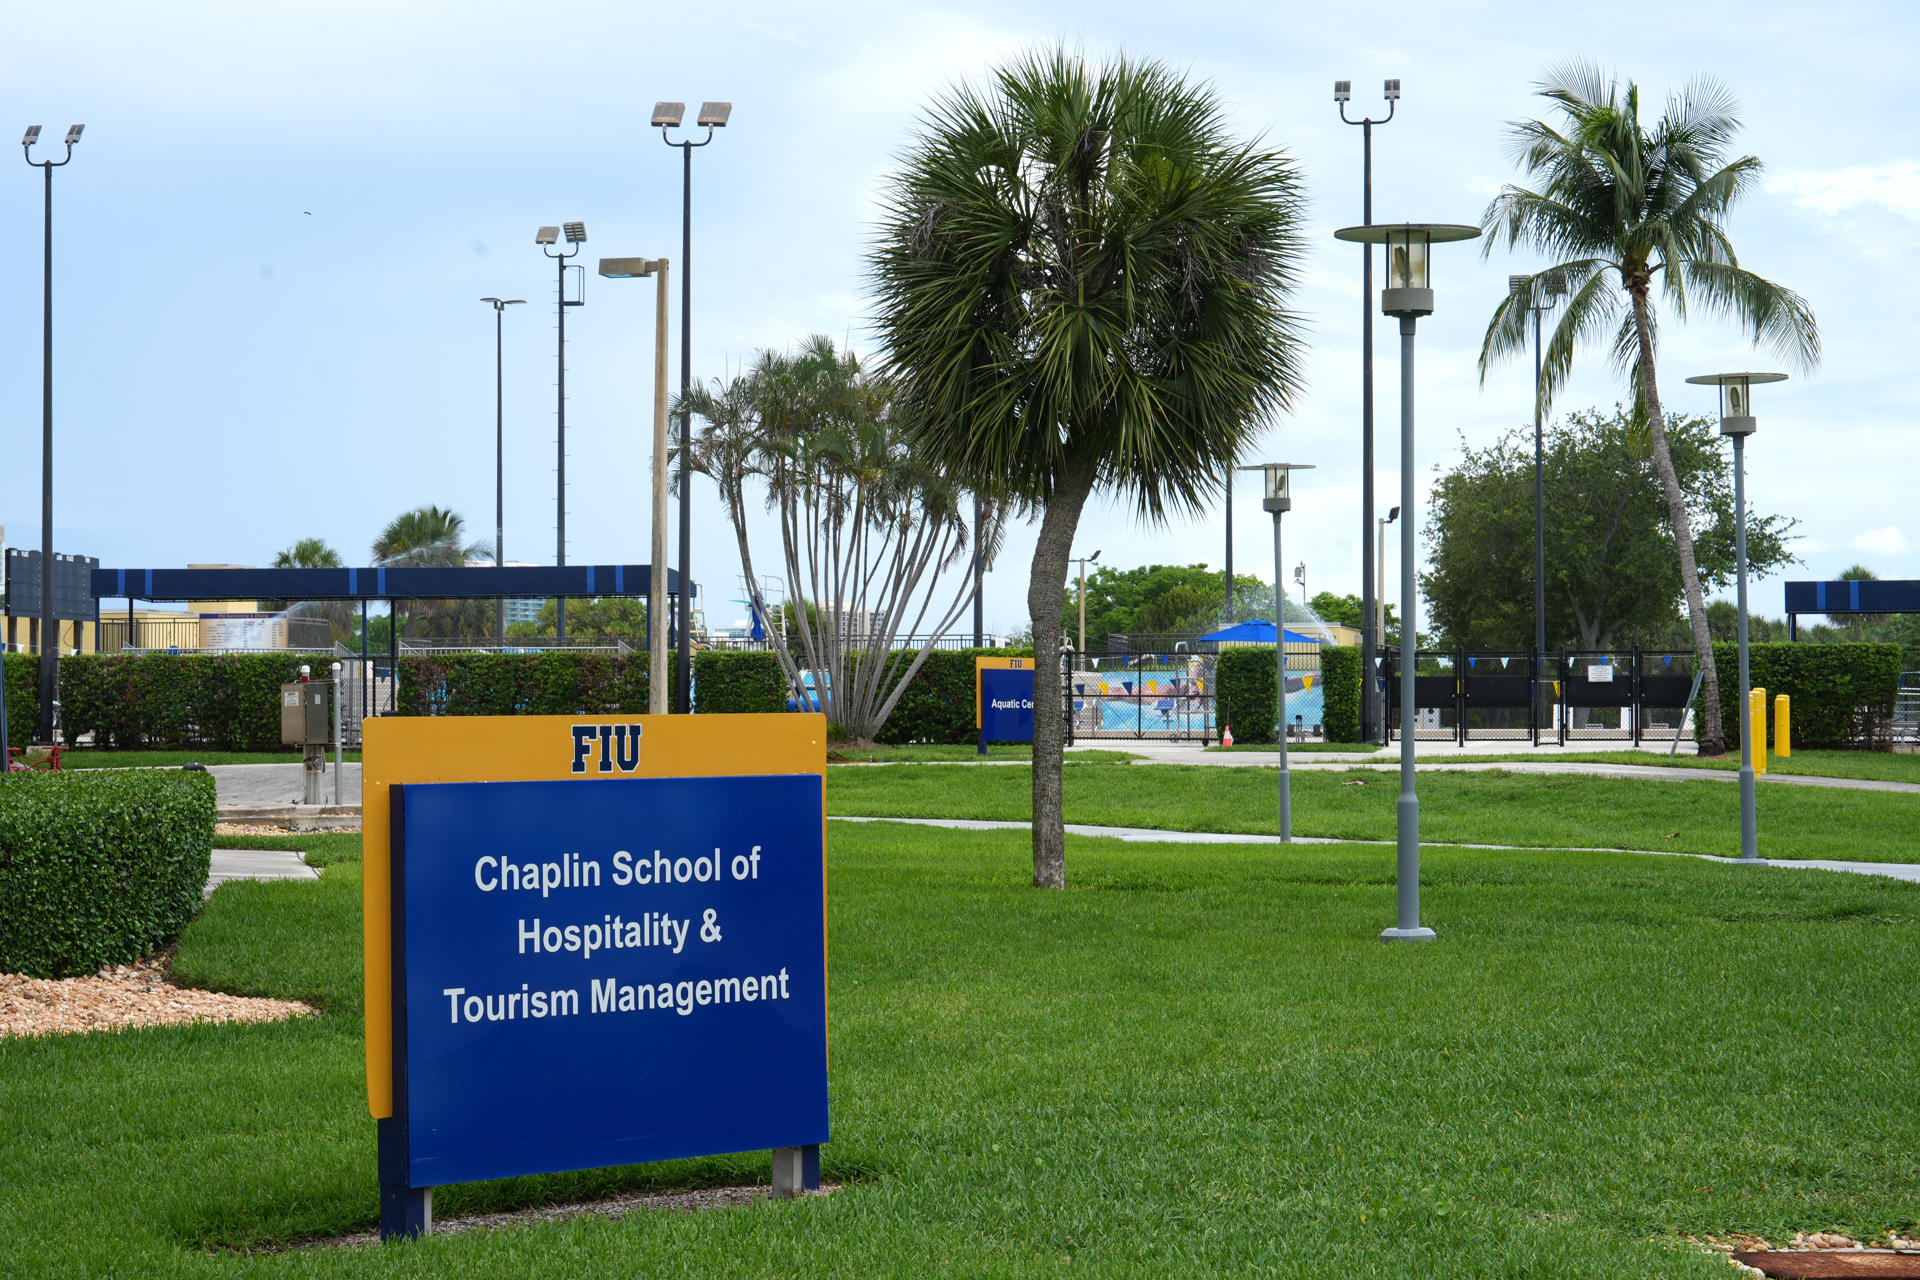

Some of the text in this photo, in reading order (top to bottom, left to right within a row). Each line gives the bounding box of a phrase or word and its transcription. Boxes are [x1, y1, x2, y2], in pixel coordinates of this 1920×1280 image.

[1009, 659, 1022, 668] FIU
[991, 698, 1020, 710] Aquatic
[571, 723, 642, 774] FIU
[474, 845, 762, 898] Chaplin School of
[518, 908, 723, 959] Hospitality &
[443, 966, 790, 1024] Tourism Management
